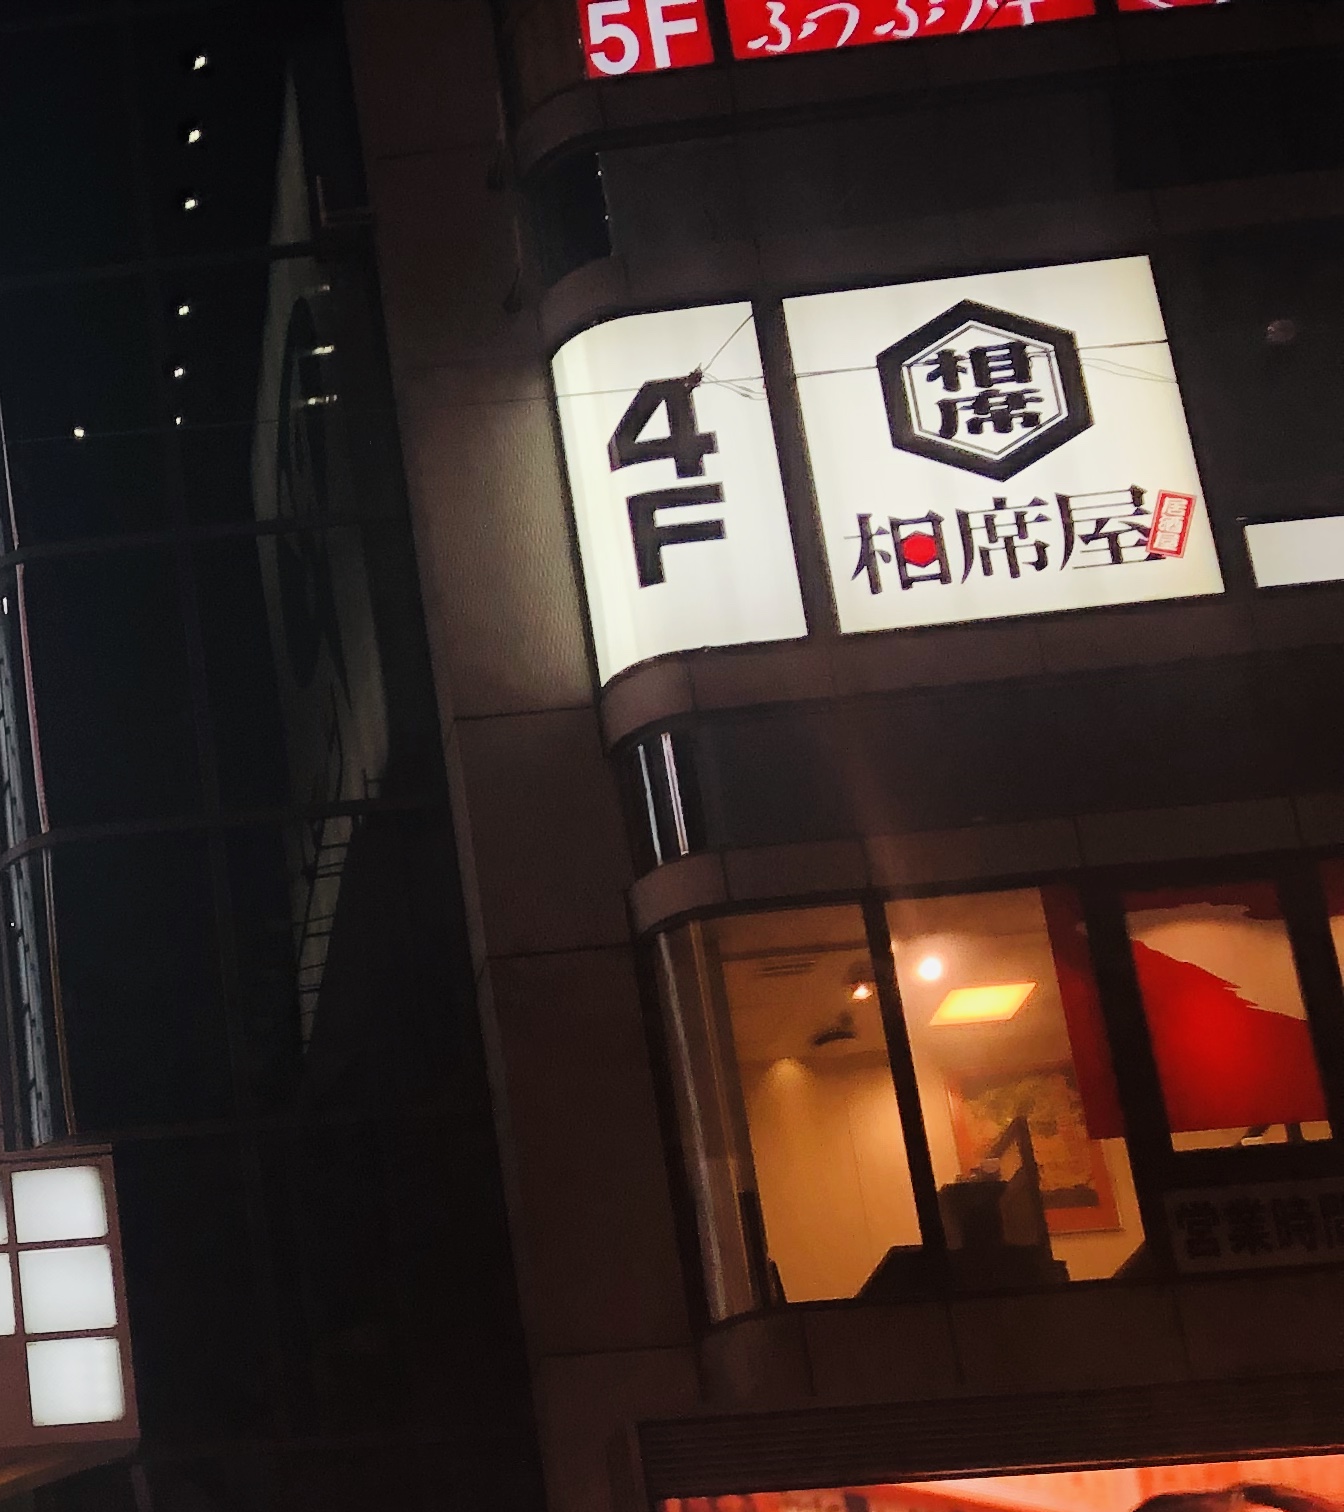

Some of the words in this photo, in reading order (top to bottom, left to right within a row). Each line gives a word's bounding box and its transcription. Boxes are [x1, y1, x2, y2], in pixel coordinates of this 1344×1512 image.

[587, 0, 702, 74] 5F
[926, 341, 1044, 441] 相席
[608, 371, 725, 588] 4F
[845, 484, 1166, 595] 相席屋
